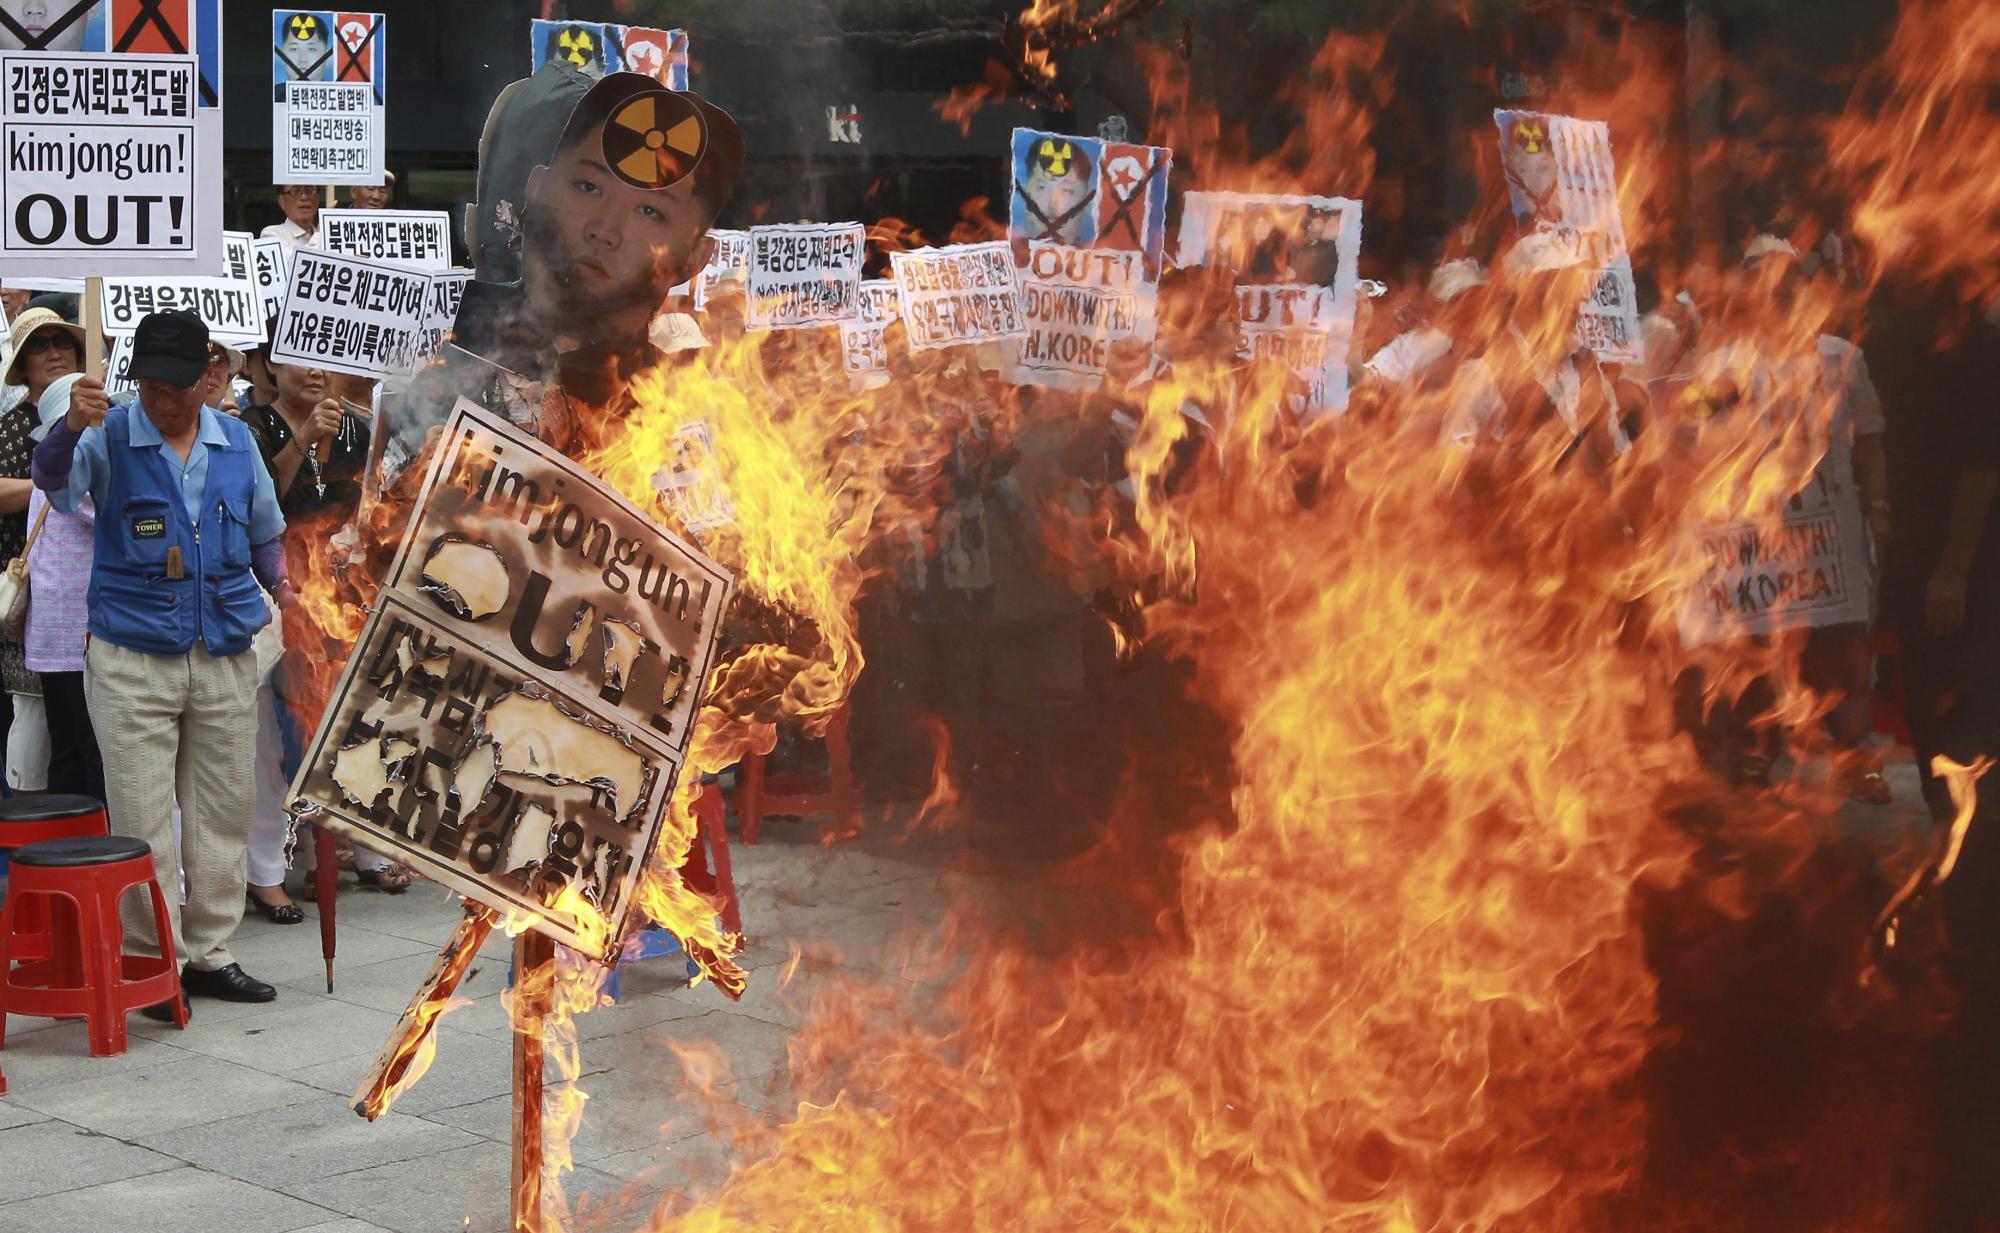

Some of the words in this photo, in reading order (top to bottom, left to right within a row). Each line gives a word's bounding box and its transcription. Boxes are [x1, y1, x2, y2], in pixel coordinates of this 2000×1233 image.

[11, 66, 189, 117] 김정은지뢰포격도발
[291, 87, 368, 112] 북핵전쟁도발협박!
[291, 117, 368, 141] 대북심리전방송!
[826, 103, 864, 145] kt
[291, 146, 369, 171] 전면확대촉구한다!
[14, 193, 185, 246] OUT!
[328, 219, 444, 260] 북핵전쟁도발협박!
[1032, 247, 1133, 290] OUT!
[109, 284, 253, 328] 강력응징하자!
[297, 258, 425, 321] 김정은체포하여
[1240, 287, 1322, 327] UT!
[1025, 329, 1105, 368] N.KORE
[135, 523, 163, 532] TOWER
